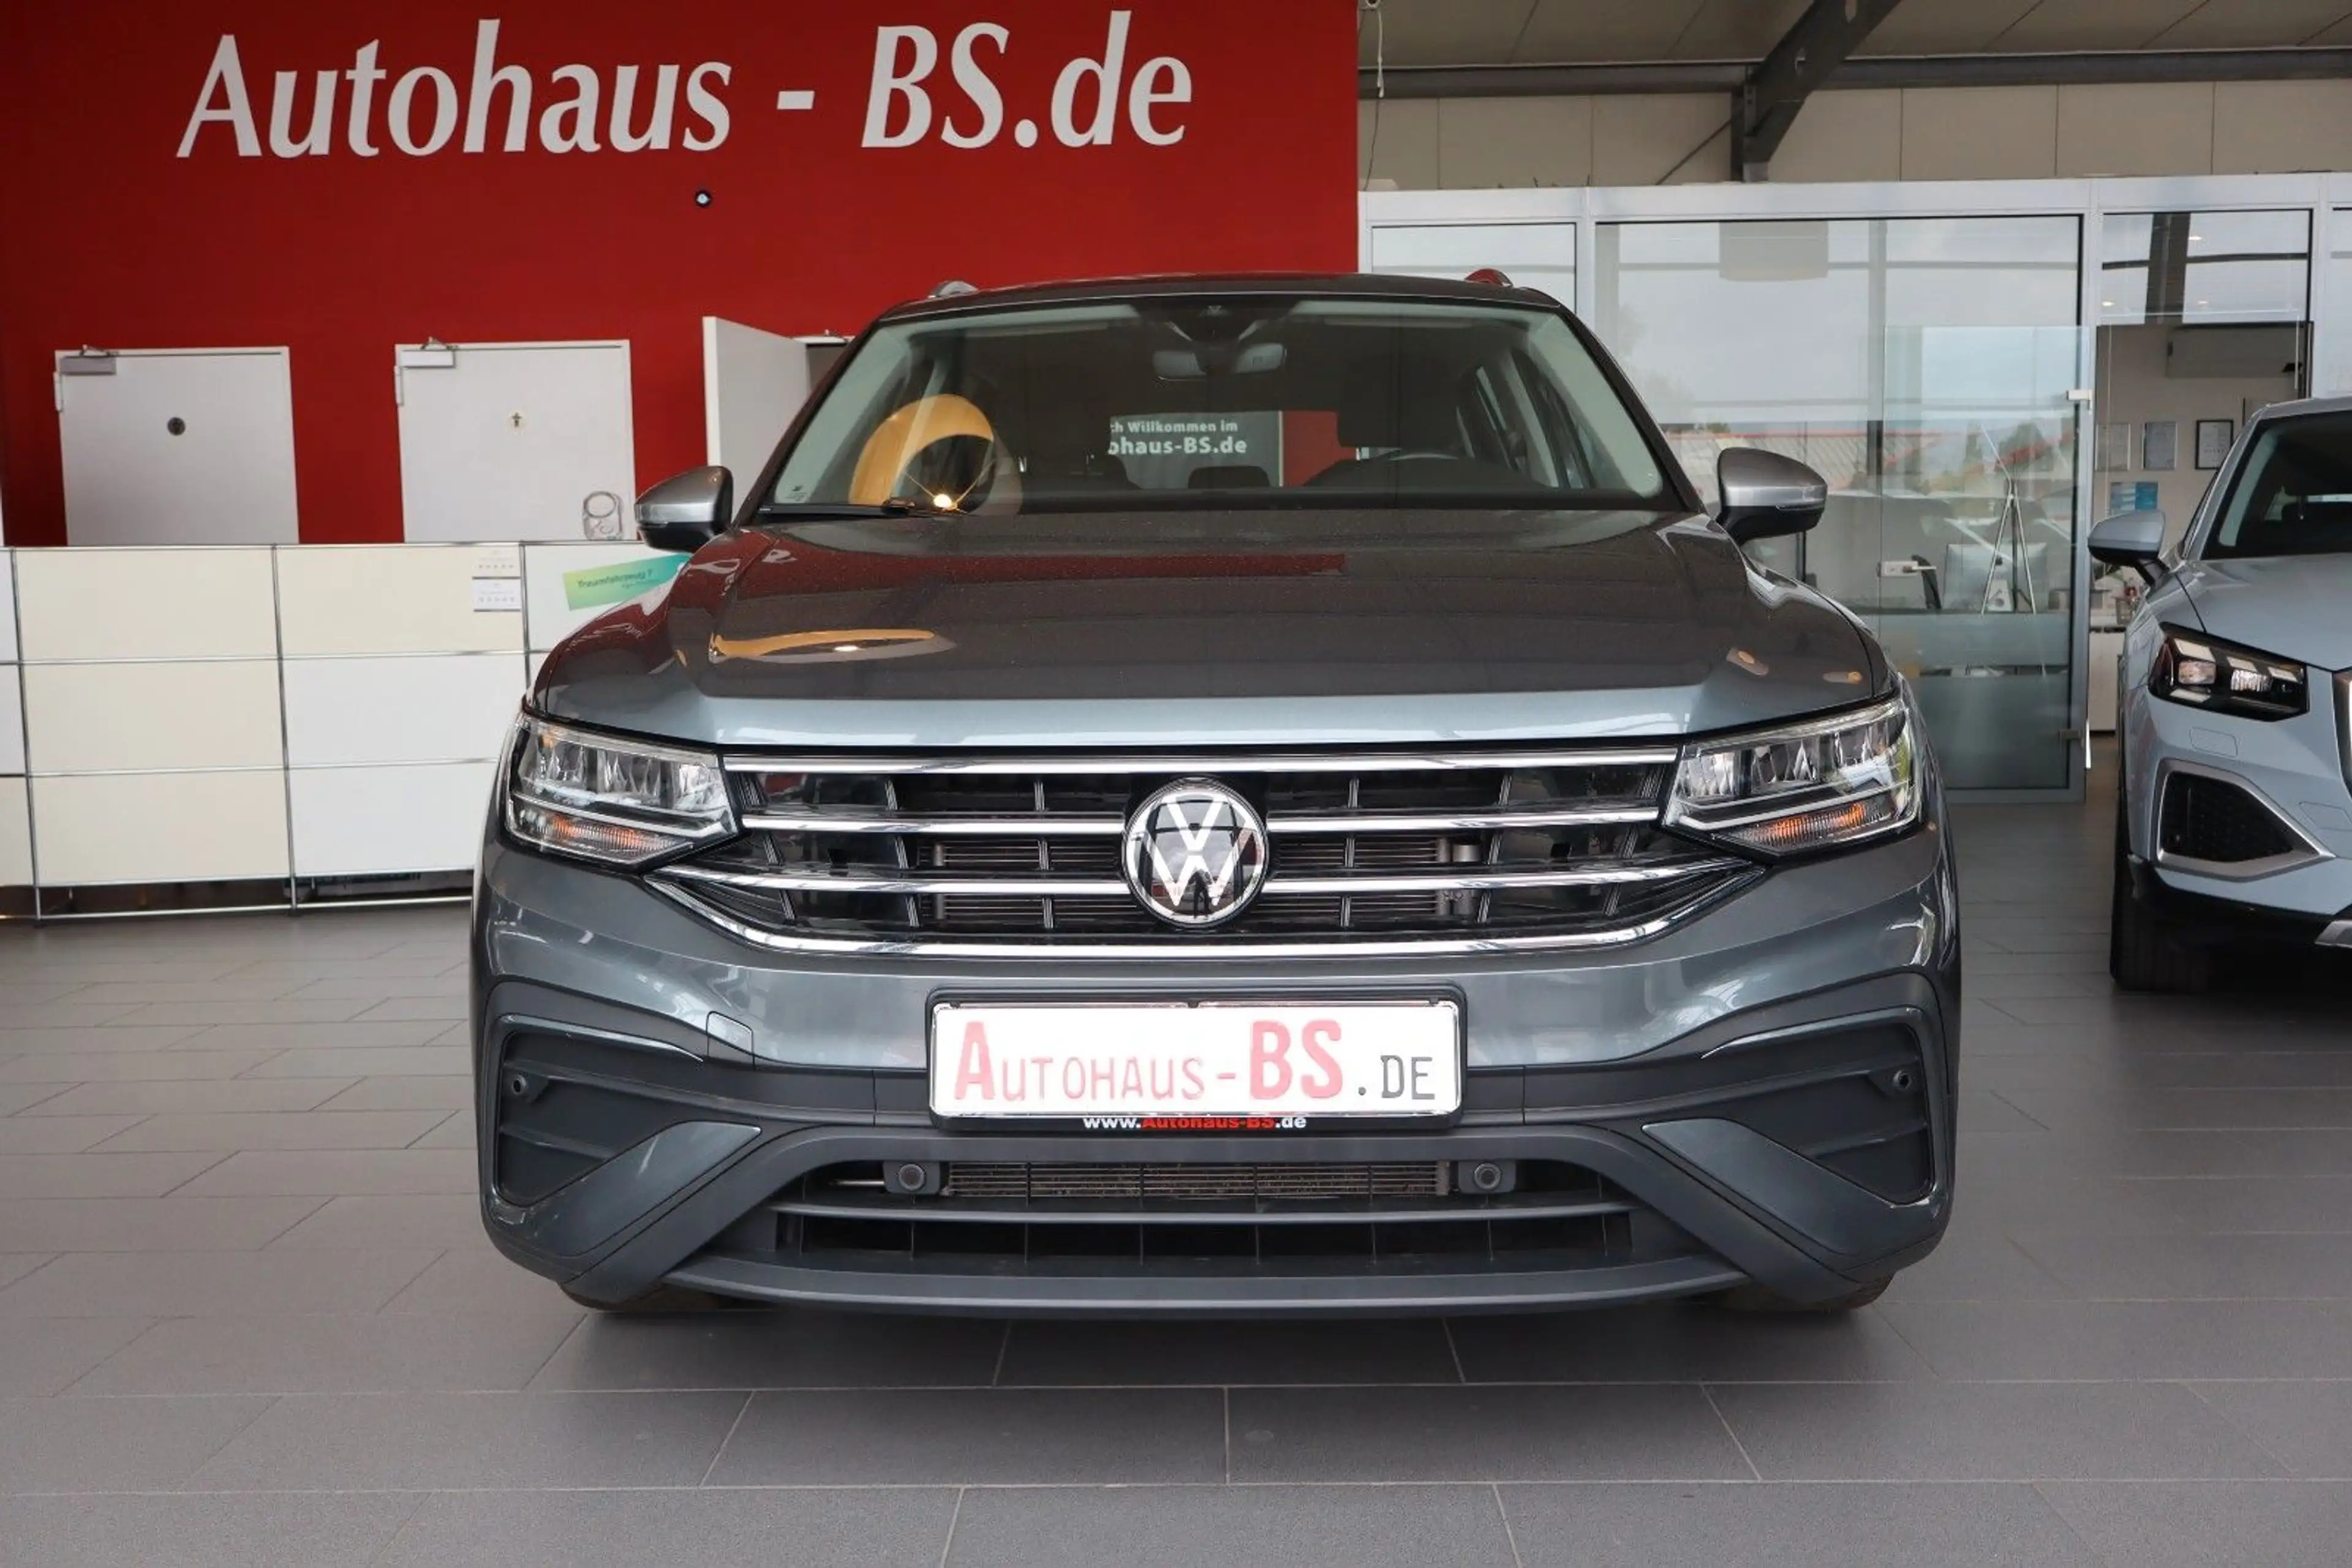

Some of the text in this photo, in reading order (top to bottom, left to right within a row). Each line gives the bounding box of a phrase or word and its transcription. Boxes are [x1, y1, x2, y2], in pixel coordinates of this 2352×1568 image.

[177, 19, 731, 157] Autohaus
[862, 10, 1191, 153] BS.de
[1128, 420, 1216, 434] Willkommen
